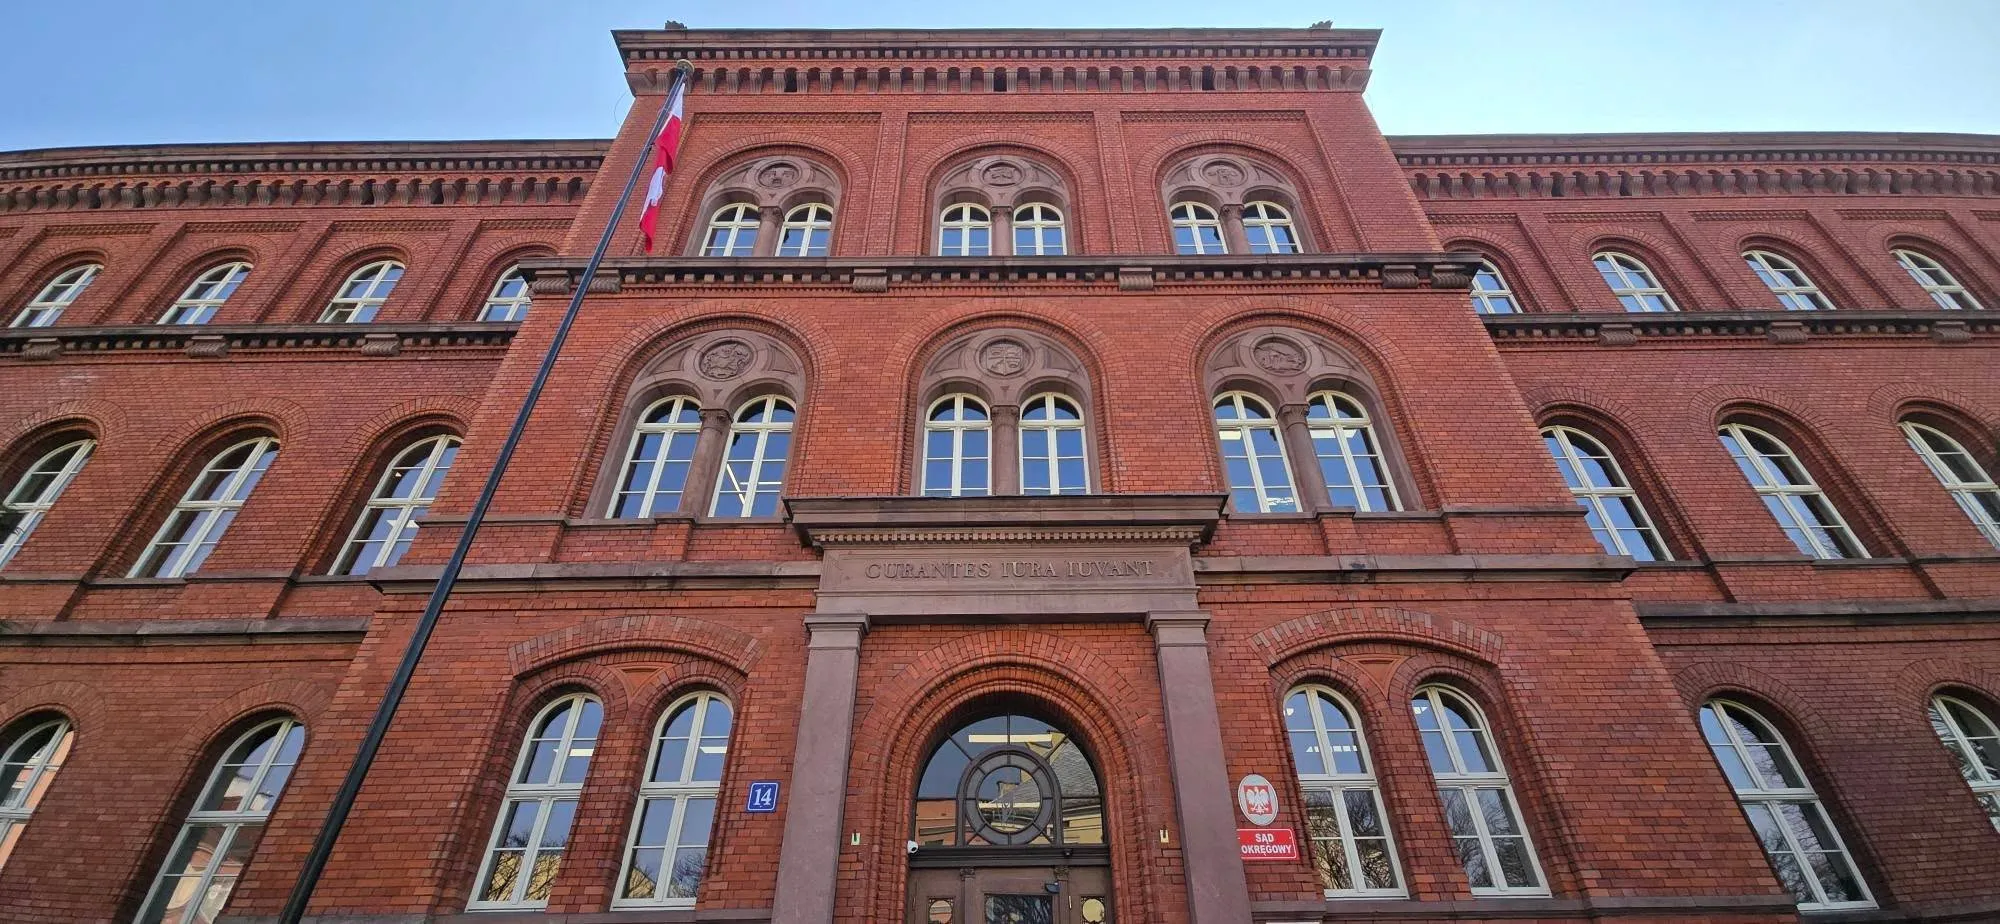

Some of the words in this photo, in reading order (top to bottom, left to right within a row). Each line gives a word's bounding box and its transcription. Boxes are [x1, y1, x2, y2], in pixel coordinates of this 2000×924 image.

[865, 561, 991, 579] CURANTES
[1001, 561, 1059, 578] IURA
[1065, 560, 1153, 577] IUVANT
[753, 788, 772, 806] 14
[1255, 833, 1274, 844] SĄD
[1241, 845, 1292, 856] OKRĘGOWY
